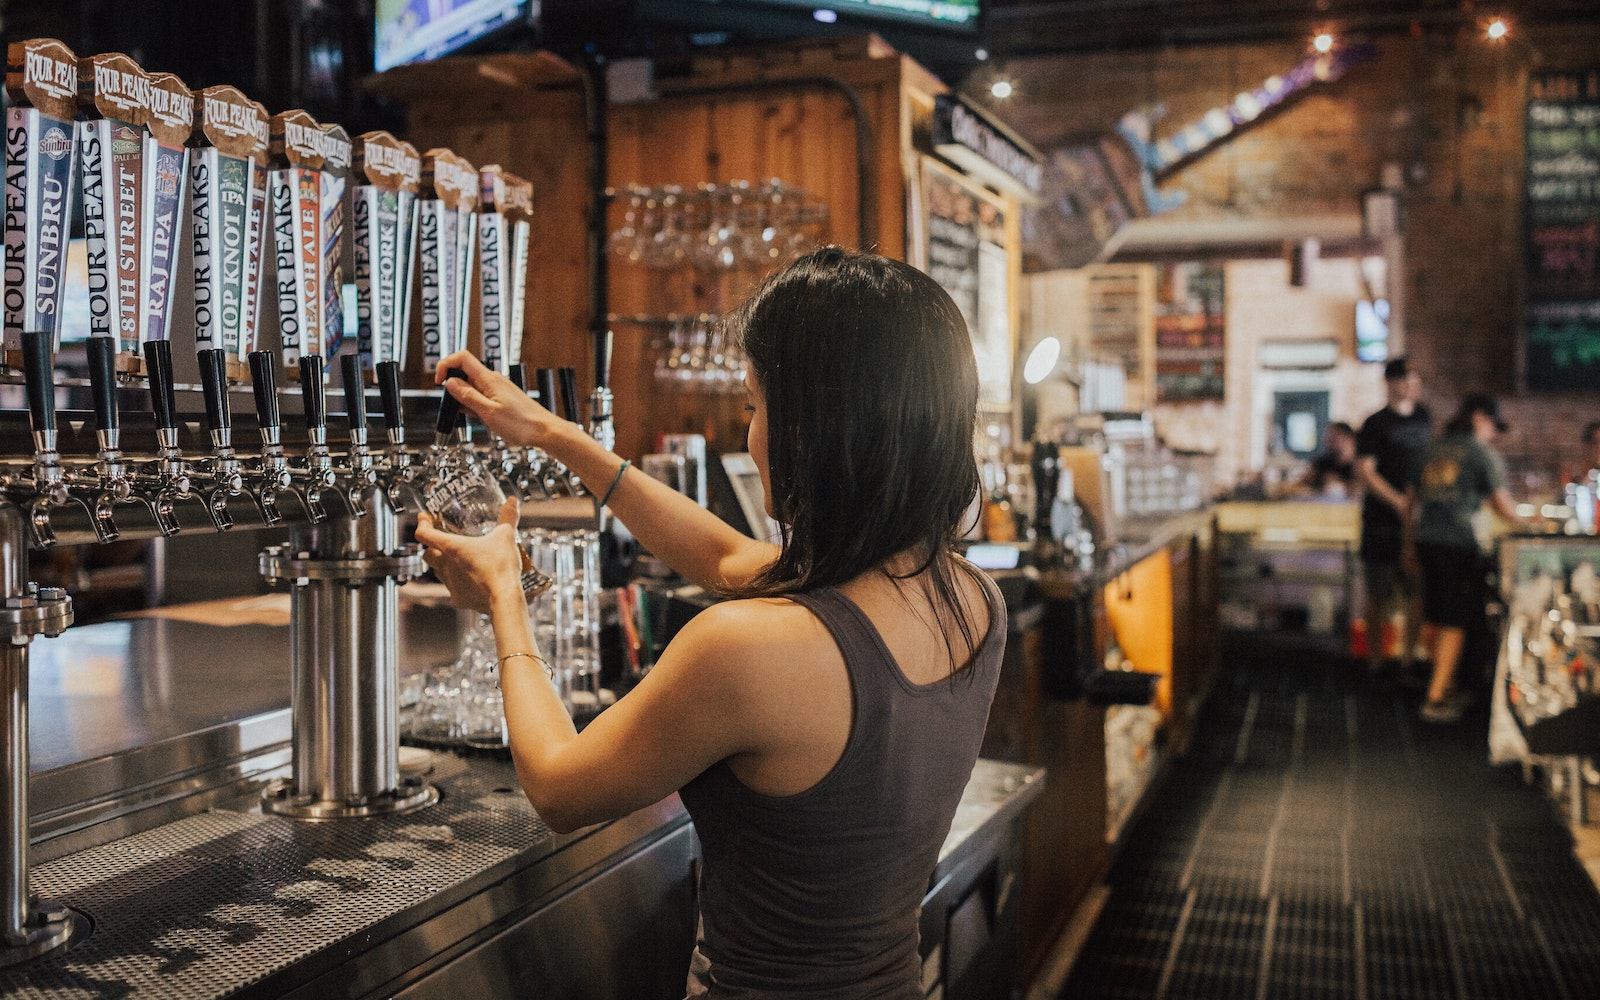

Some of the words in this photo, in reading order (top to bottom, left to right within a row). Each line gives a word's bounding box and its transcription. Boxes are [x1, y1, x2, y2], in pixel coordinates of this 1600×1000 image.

[25, 51, 53, 84] FOUR
[94, 64, 121, 97] FOUR
[121, 72, 150, 110] PEAKS
[150, 86, 169, 114] OUR
[169, 92, 195, 127] PEAKS
[204, 97, 229, 125] FOUR
[229, 103, 258, 137] PEAKS
[285, 122, 304, 148] FOUR
[6, 126, 28, 234] PEAKS
[39, 139, 72, 153] Sunbru
[113, 153, 131, 163] PALE
[81, 137, 107, 241] PEAKS
[119, 166, 137, 272] STREET
[192, 163, 210, 257] PEAKS
[221, 191, 246, 206] IPA
[36, 174, 63, 315] SUNBRU
[153, 210, 172, 260] IPA
[223, 208, 241, 287] KNOT
[273, 184, 296, 270] PEAKS
[302, 209, 315, 257] ALE
[354, 199, 370, 279] PEAKS
[421, 213, 438, 288] PEAKS
[4, 240, 26, 331] FOUR
[88, 247, 110, 335] FOUR
[148, 266, 169, 319] RAJ
[380, 224, 395, 360] PITCHFORK
[481, 227, 499, 296] PEAKS
[120, 275, 136, 333] 8TH
[195, 262, 213, 343] FOUR
[222, 289, 239, 348] HOP
[279, 277, 299, 349] FOUR
[304, 262, 319, 345] PEACH
[355, 285, 371, 353] FOUR
[423, 295, 440, 357] FOUR
[484, 303, 501, 361] FOUR
[425, 487, 451, 519] FOUR
